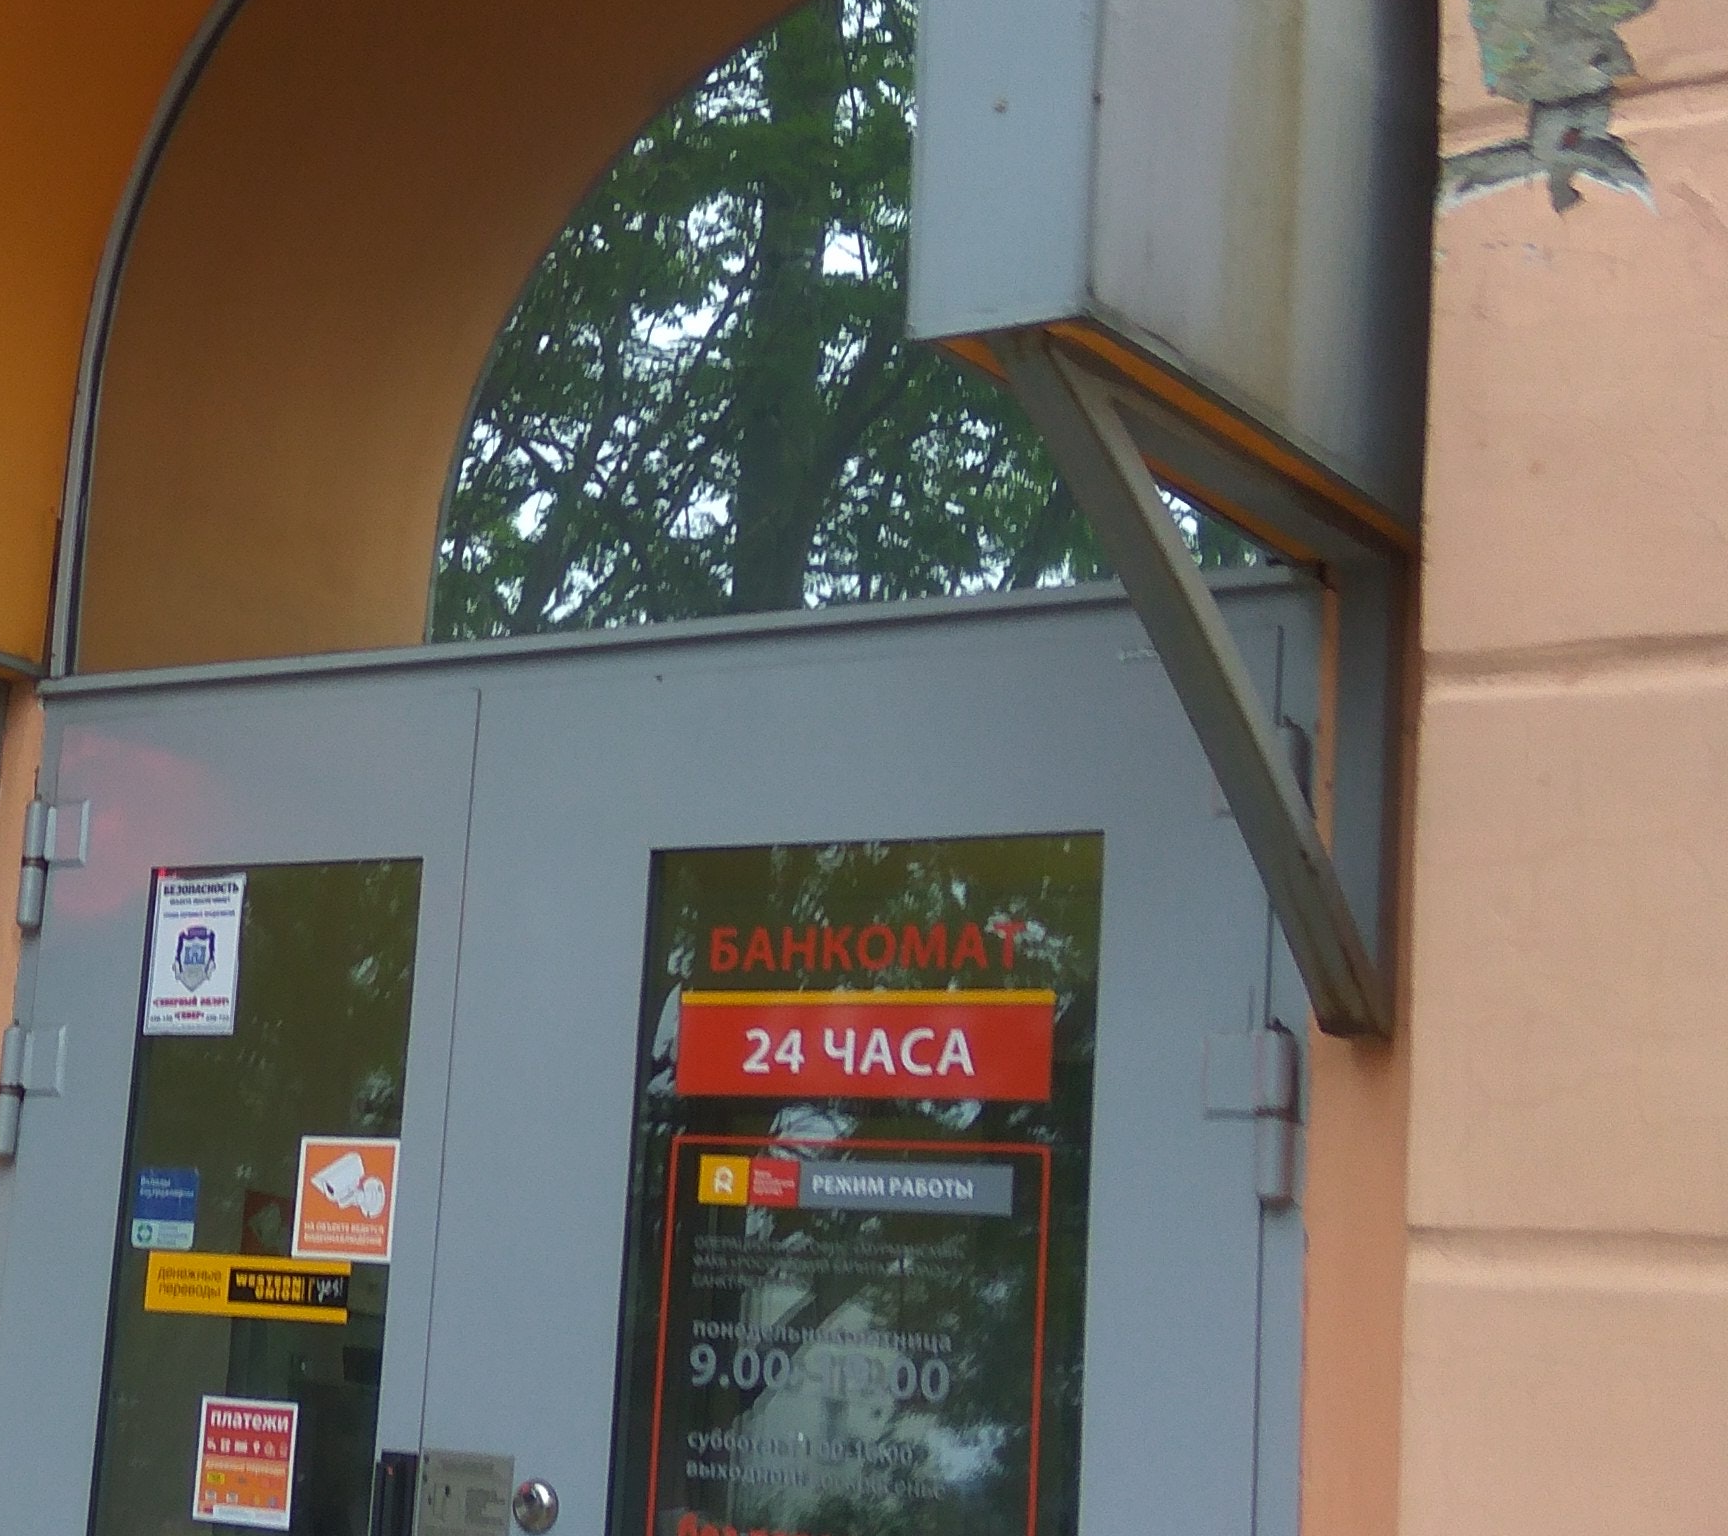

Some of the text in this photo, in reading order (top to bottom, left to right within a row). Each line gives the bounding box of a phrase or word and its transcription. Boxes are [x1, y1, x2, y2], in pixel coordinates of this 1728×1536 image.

[709, 920, 1027, 973] БАНКОМАТ
[742, 1026, 976, 1077] 24 ЧАСА
[811, 1174, 885, 1197] РЕЖИМ
[888, 1175, 975, 1201] РАБОТЫ
[210, 1409, 290, 1434] платежи
